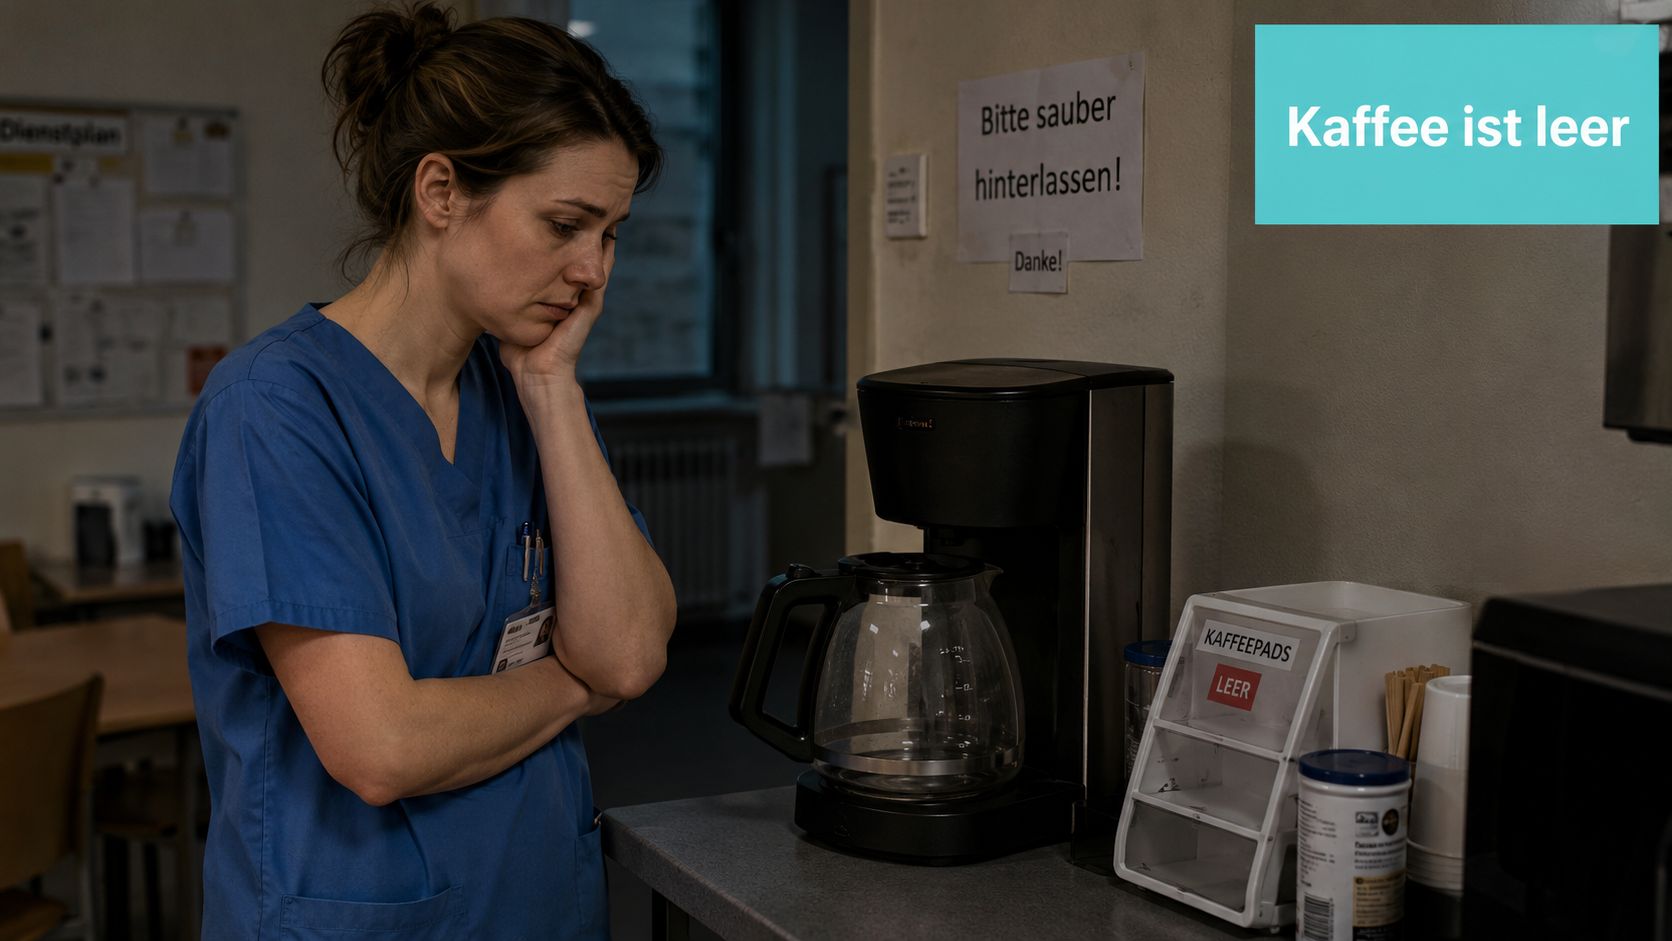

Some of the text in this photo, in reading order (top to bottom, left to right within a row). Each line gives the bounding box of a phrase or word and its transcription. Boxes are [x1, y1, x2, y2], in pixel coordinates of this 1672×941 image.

[981, 91, 1117, 135] Bitte sauber
[0, 118, 120, 147] Dienstplan
[975, 156, 1122, 201] hinterlassen!
[1014, 249, 1063, 273] Danke!
[1203, 628, 1293, 663] KAFFEEPADS
[1215, 673, 1252, 700] LEER
